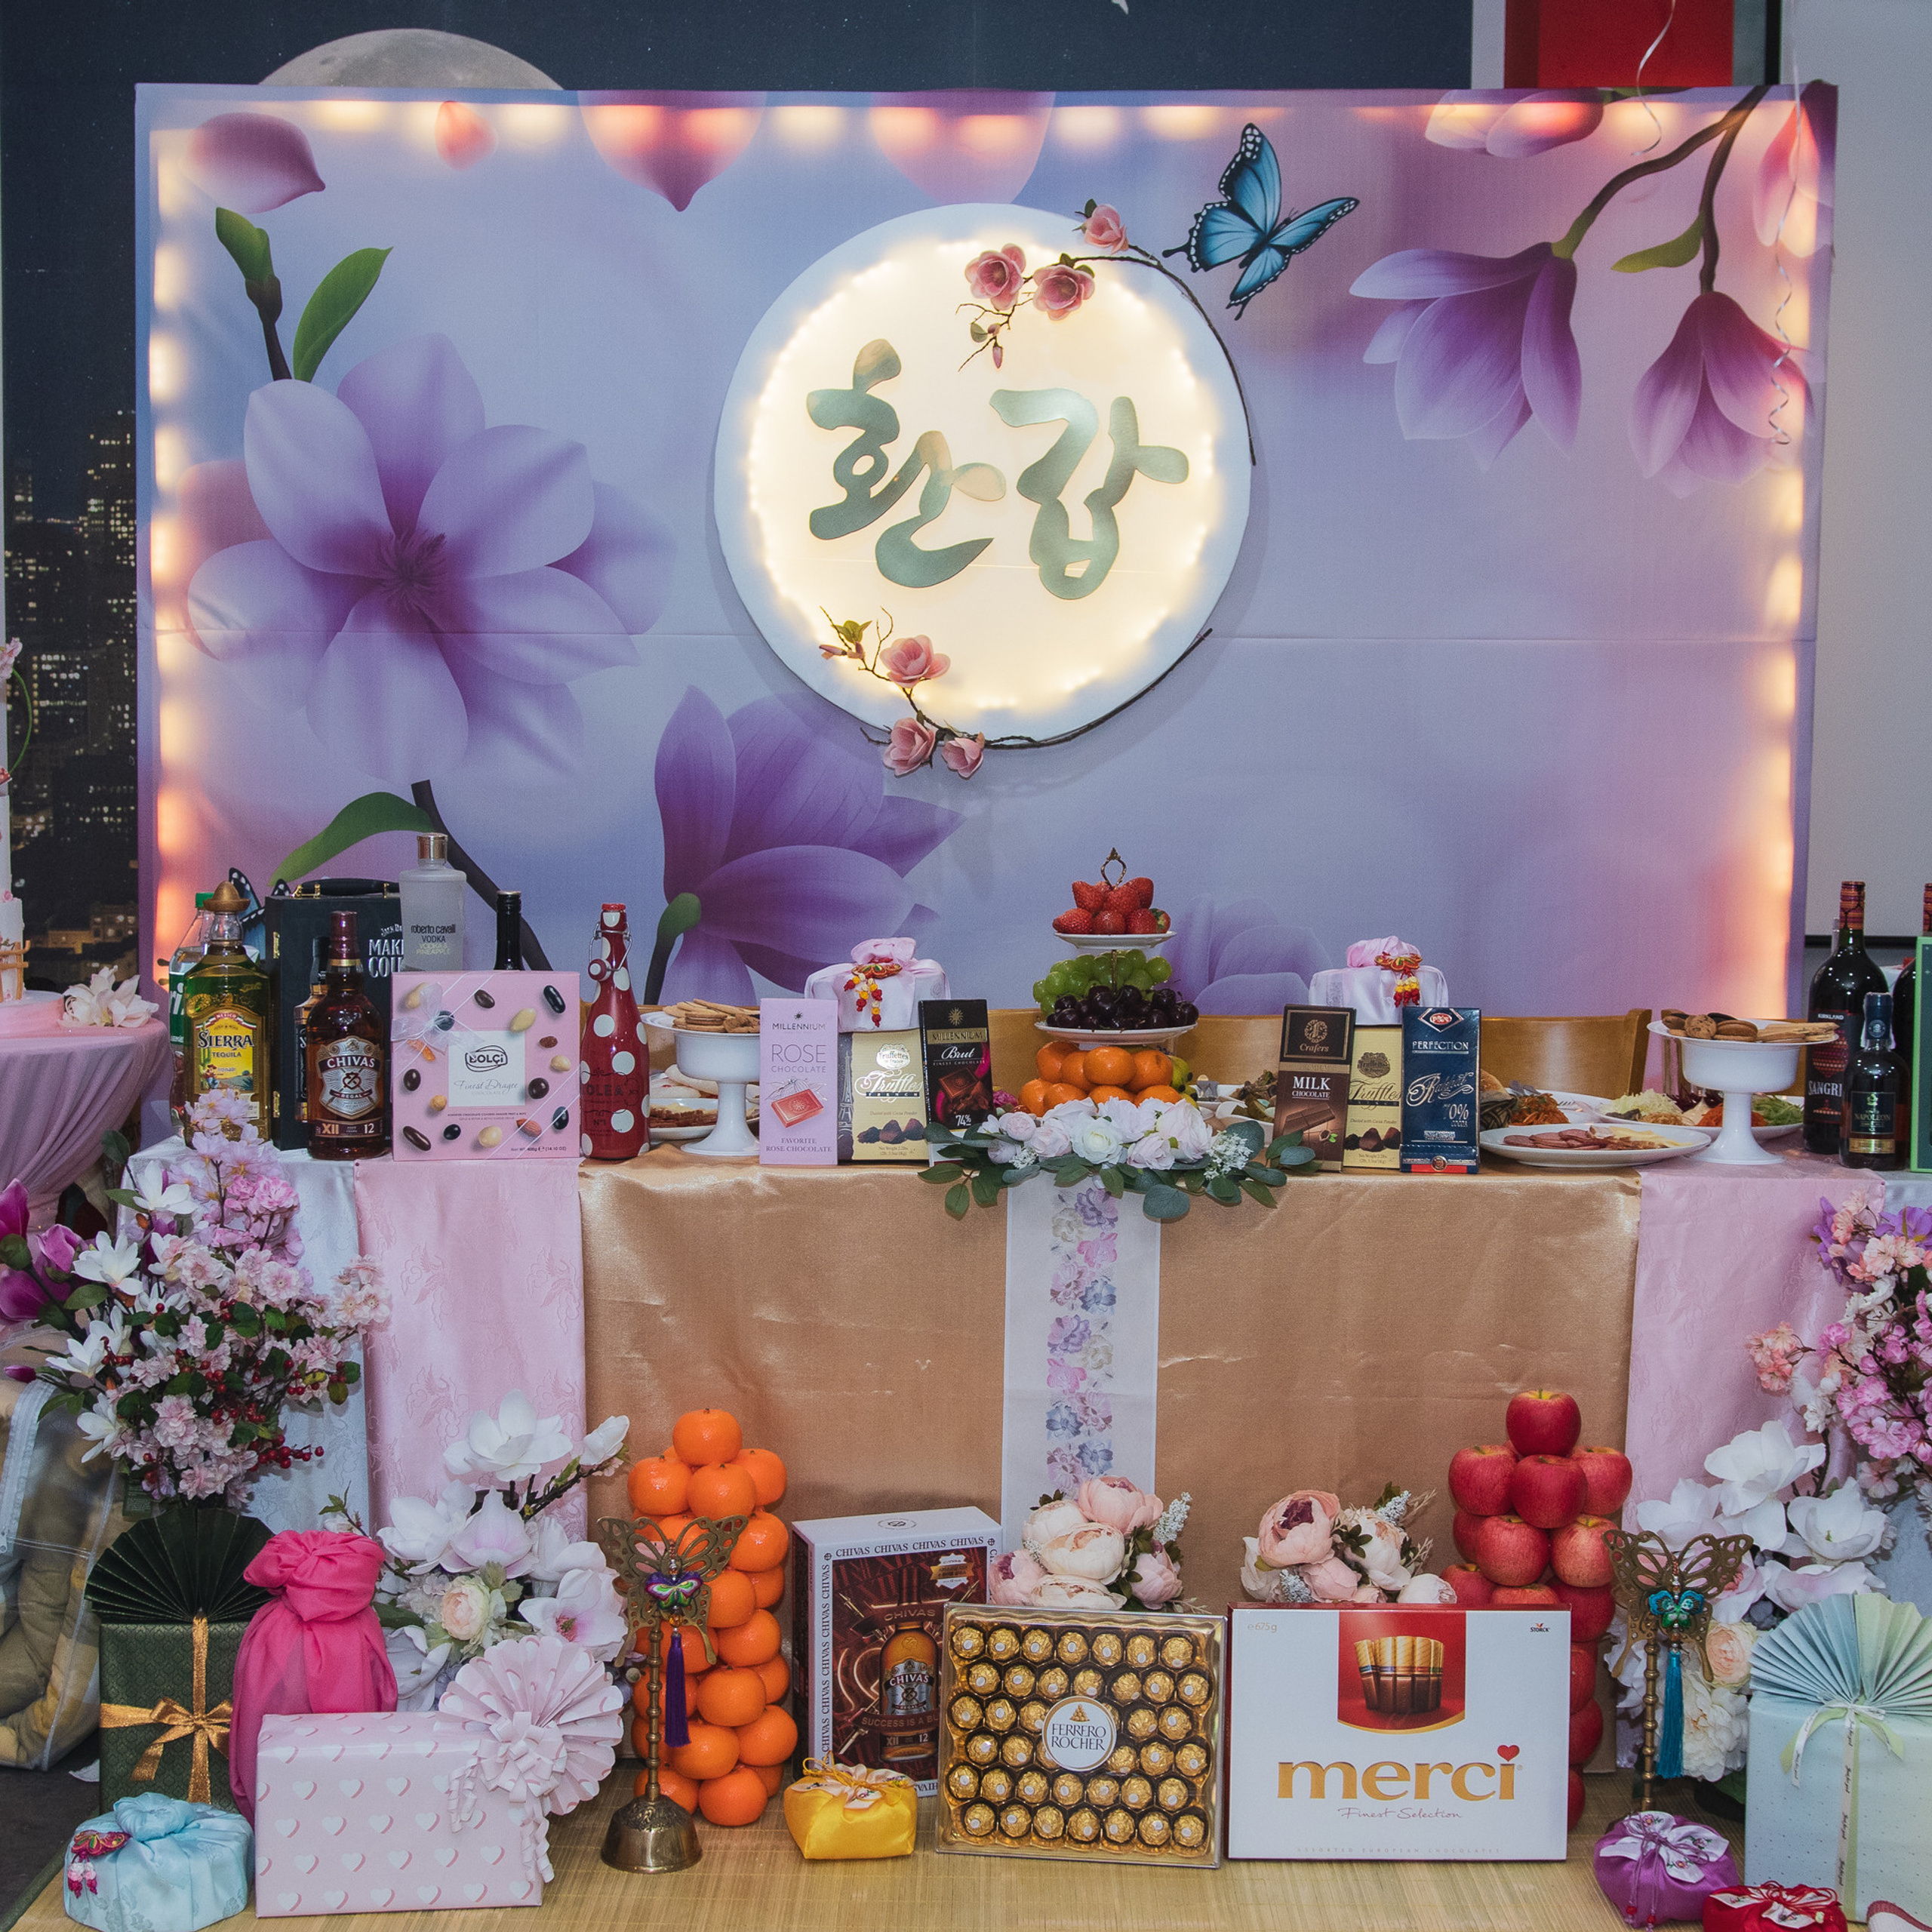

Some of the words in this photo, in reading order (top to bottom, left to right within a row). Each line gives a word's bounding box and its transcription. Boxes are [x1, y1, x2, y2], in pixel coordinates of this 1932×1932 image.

[807, 339, 1189, 600] 환갑
[411, 924, 434, 934] roberto
[197, 1029, 254, 1050] SIERRA
[932, 1032, 983, 1041] MILLENNIUM
[941, 1045, 975, 1060] Brut
[1300, 1043, 1329, 1053] Crafers
[1412, 1041, 1469, 1050] PERFECTION
[771, 1044, 826, 1063] ROSE
[327, 1057, 376, 1068] CHIVAS
[586, 1084, 623, 1096] OLEA
[854, 1069, 923, 1096] Truffles
[1293, 1076, 1331, 1091] MILK
[1349, 1078, 1402, 1101] Truffles
[1808, 1080, 1842, 1097] SANGRI
[955, 1114, 971, 1126] 74%
[321, 1123, 340, 1134] XII
[364, 1123, 374, 1134] 12
[835, 1547, 870, 1557] CHIVAS
[874, 1543, 909, 1554] CHIVAS
[912, 1540, 946, 1550] CHIVAS
[950, 1536, 984, 1547] CHIVAS
[822, 1564, 830, 1599] CHIVAS
[822, 1602, 830, 1638] CHIVAS
[884, 1609, 936, 1621] CHIVAS
[822, 1641, 830, 1676] CHIVAS
[890, 1674, 930, 1686] CHIVAS
[822, 1680, 830, 1715] CHIVAS
[861, 1717, 904, 1727] SUCCESS
[906, 1718, 915, 1727] IS
[822, 1718, 830, 1752] CHIVAS
[1052, 1723, 1106, 1738] FERRERO
[886, 1737, 899, 1746] XII
[919, 1733, 928, 1743] 12
[1051, 1736, 1106, 1751] ROCHER
[1277, 1745, 1520, 1801] merci
[1337, 1807, 1395, 1819] Finest
[1397, 1807, 1463, 1820] Selection
